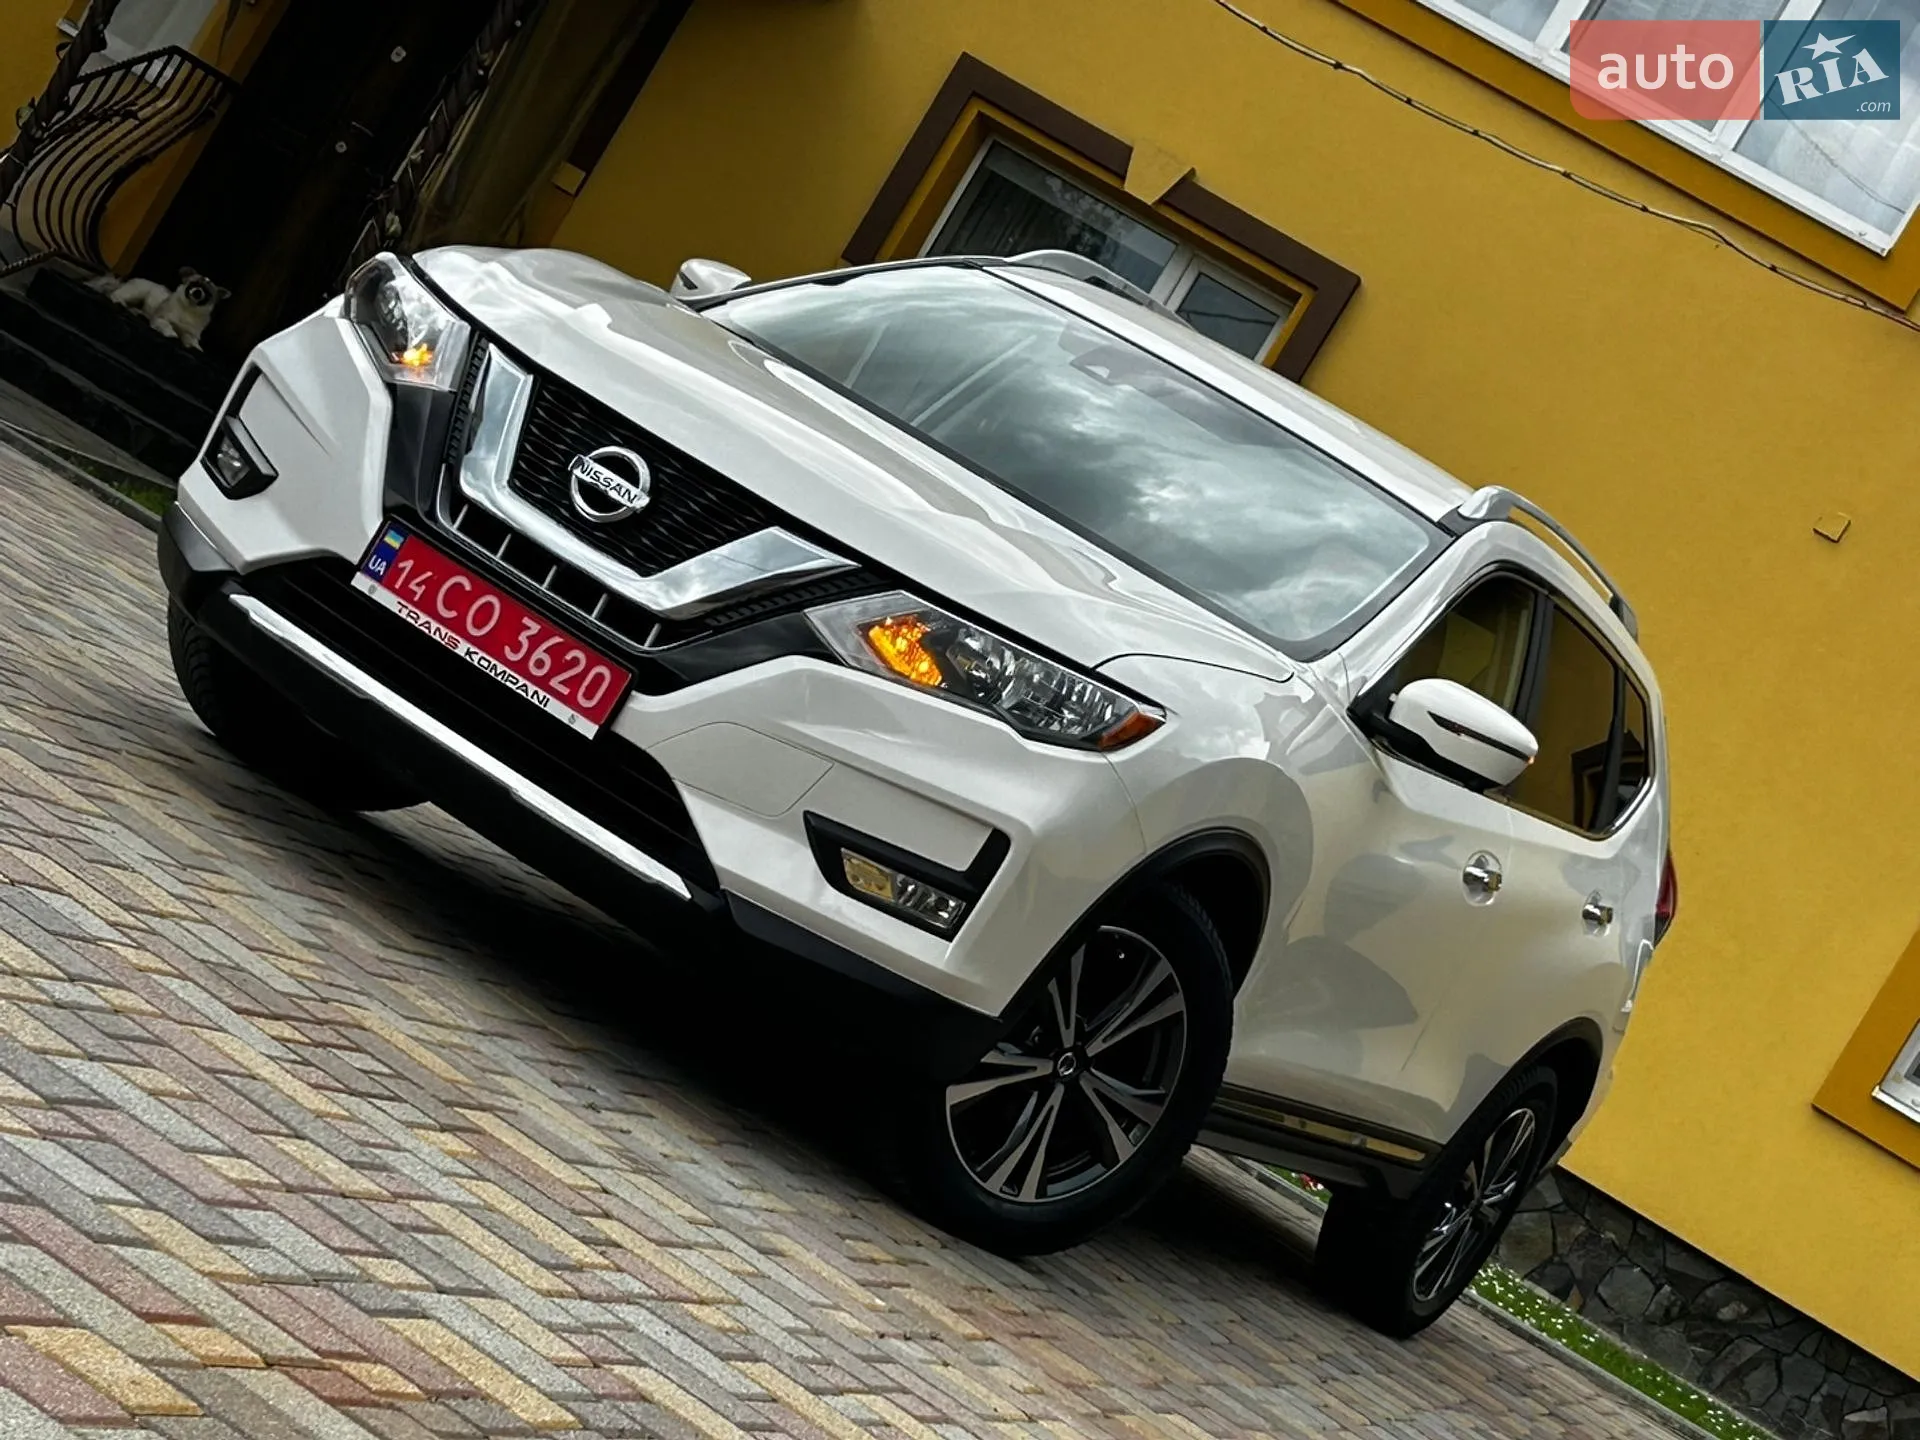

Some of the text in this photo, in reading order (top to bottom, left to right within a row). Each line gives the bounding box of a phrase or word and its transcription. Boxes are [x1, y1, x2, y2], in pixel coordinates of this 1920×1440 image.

[578, 460, 638, 504] NISSAN
[368, 554, 387, 576] UA
[397, 601, 550, 708] TRANS KOMPANI
[504, 616, 611, 708] 3620
